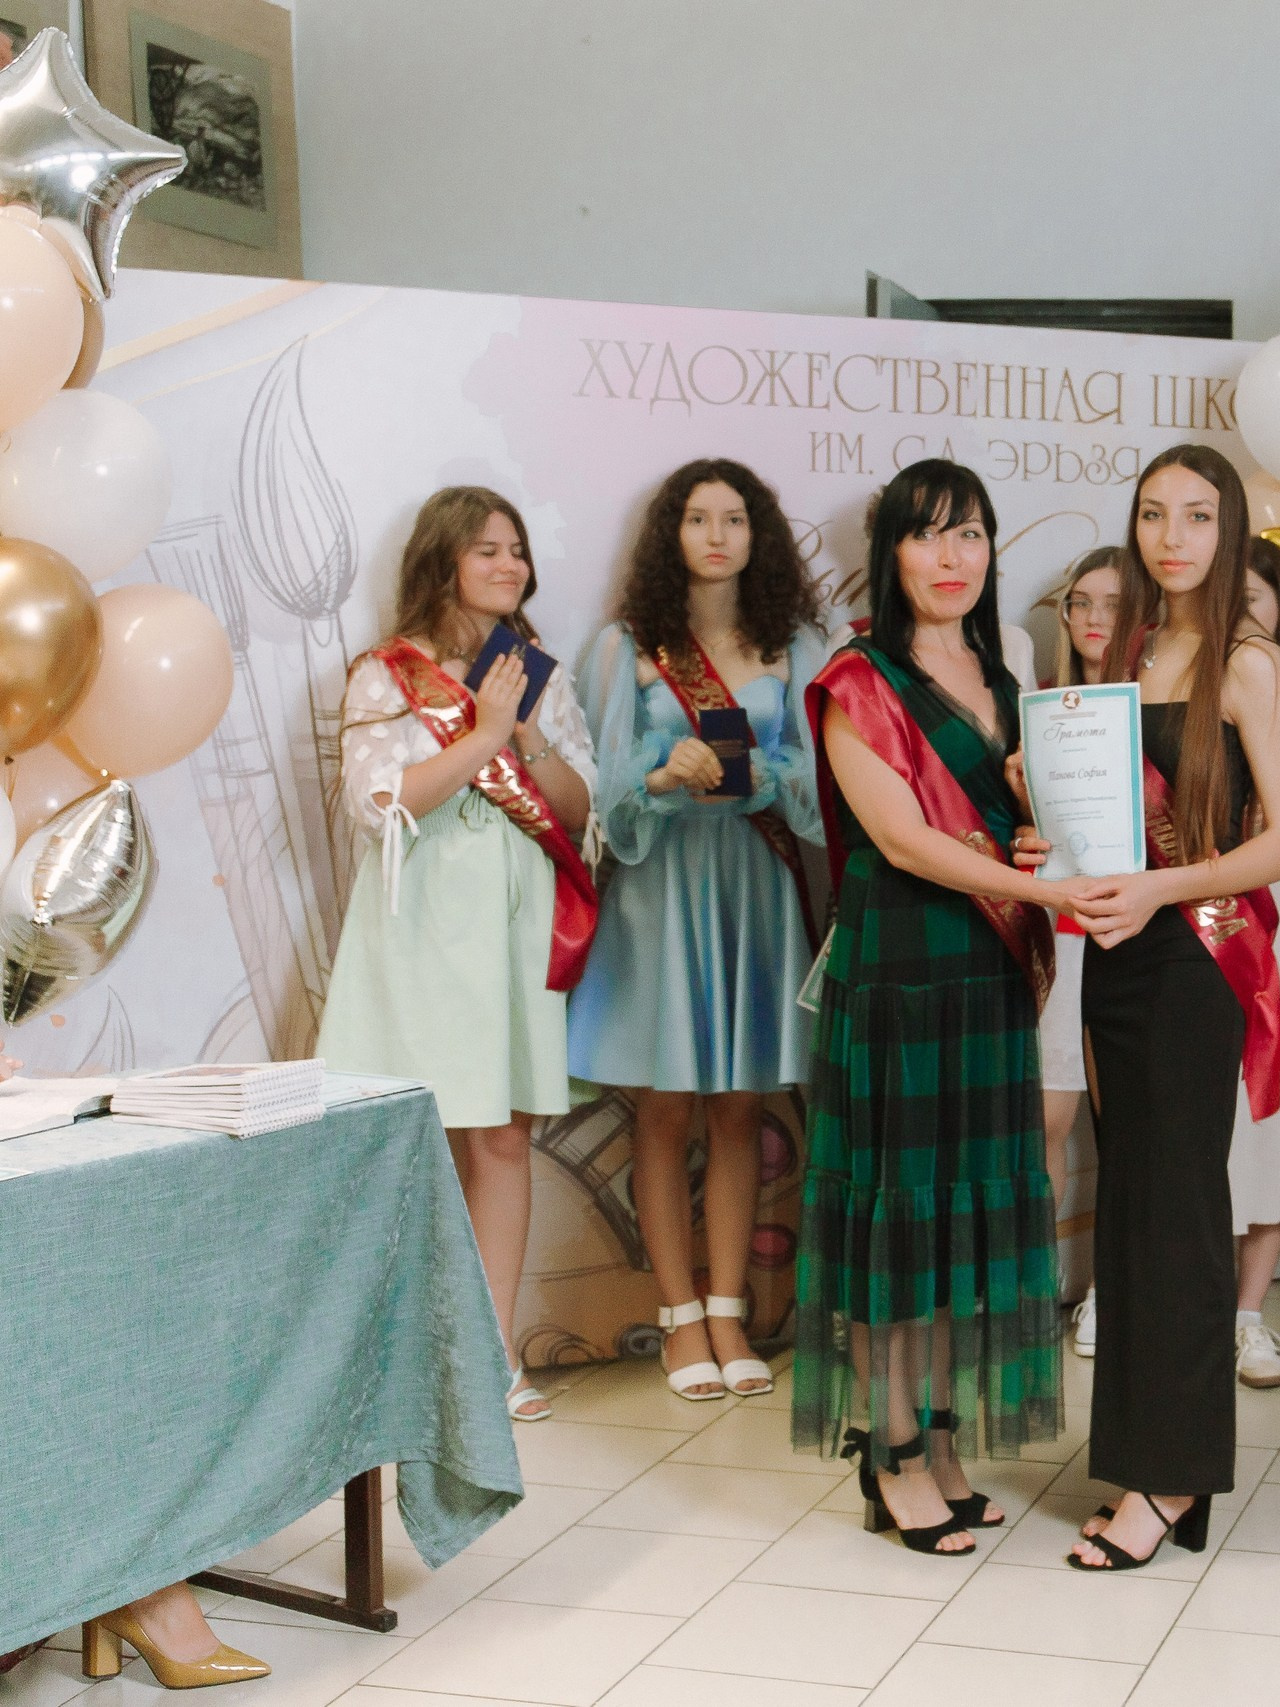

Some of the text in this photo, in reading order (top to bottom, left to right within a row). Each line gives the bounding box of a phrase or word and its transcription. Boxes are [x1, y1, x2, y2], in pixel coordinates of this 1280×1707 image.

[571, 337, 1238, 431] ХУДОЖЕСТВЕННАЯ ШК
[808, 430, 875, 476] ИМ.
[1043, 722, 1107, 743] Грамота
[1077, 765, 1108, 781] София
